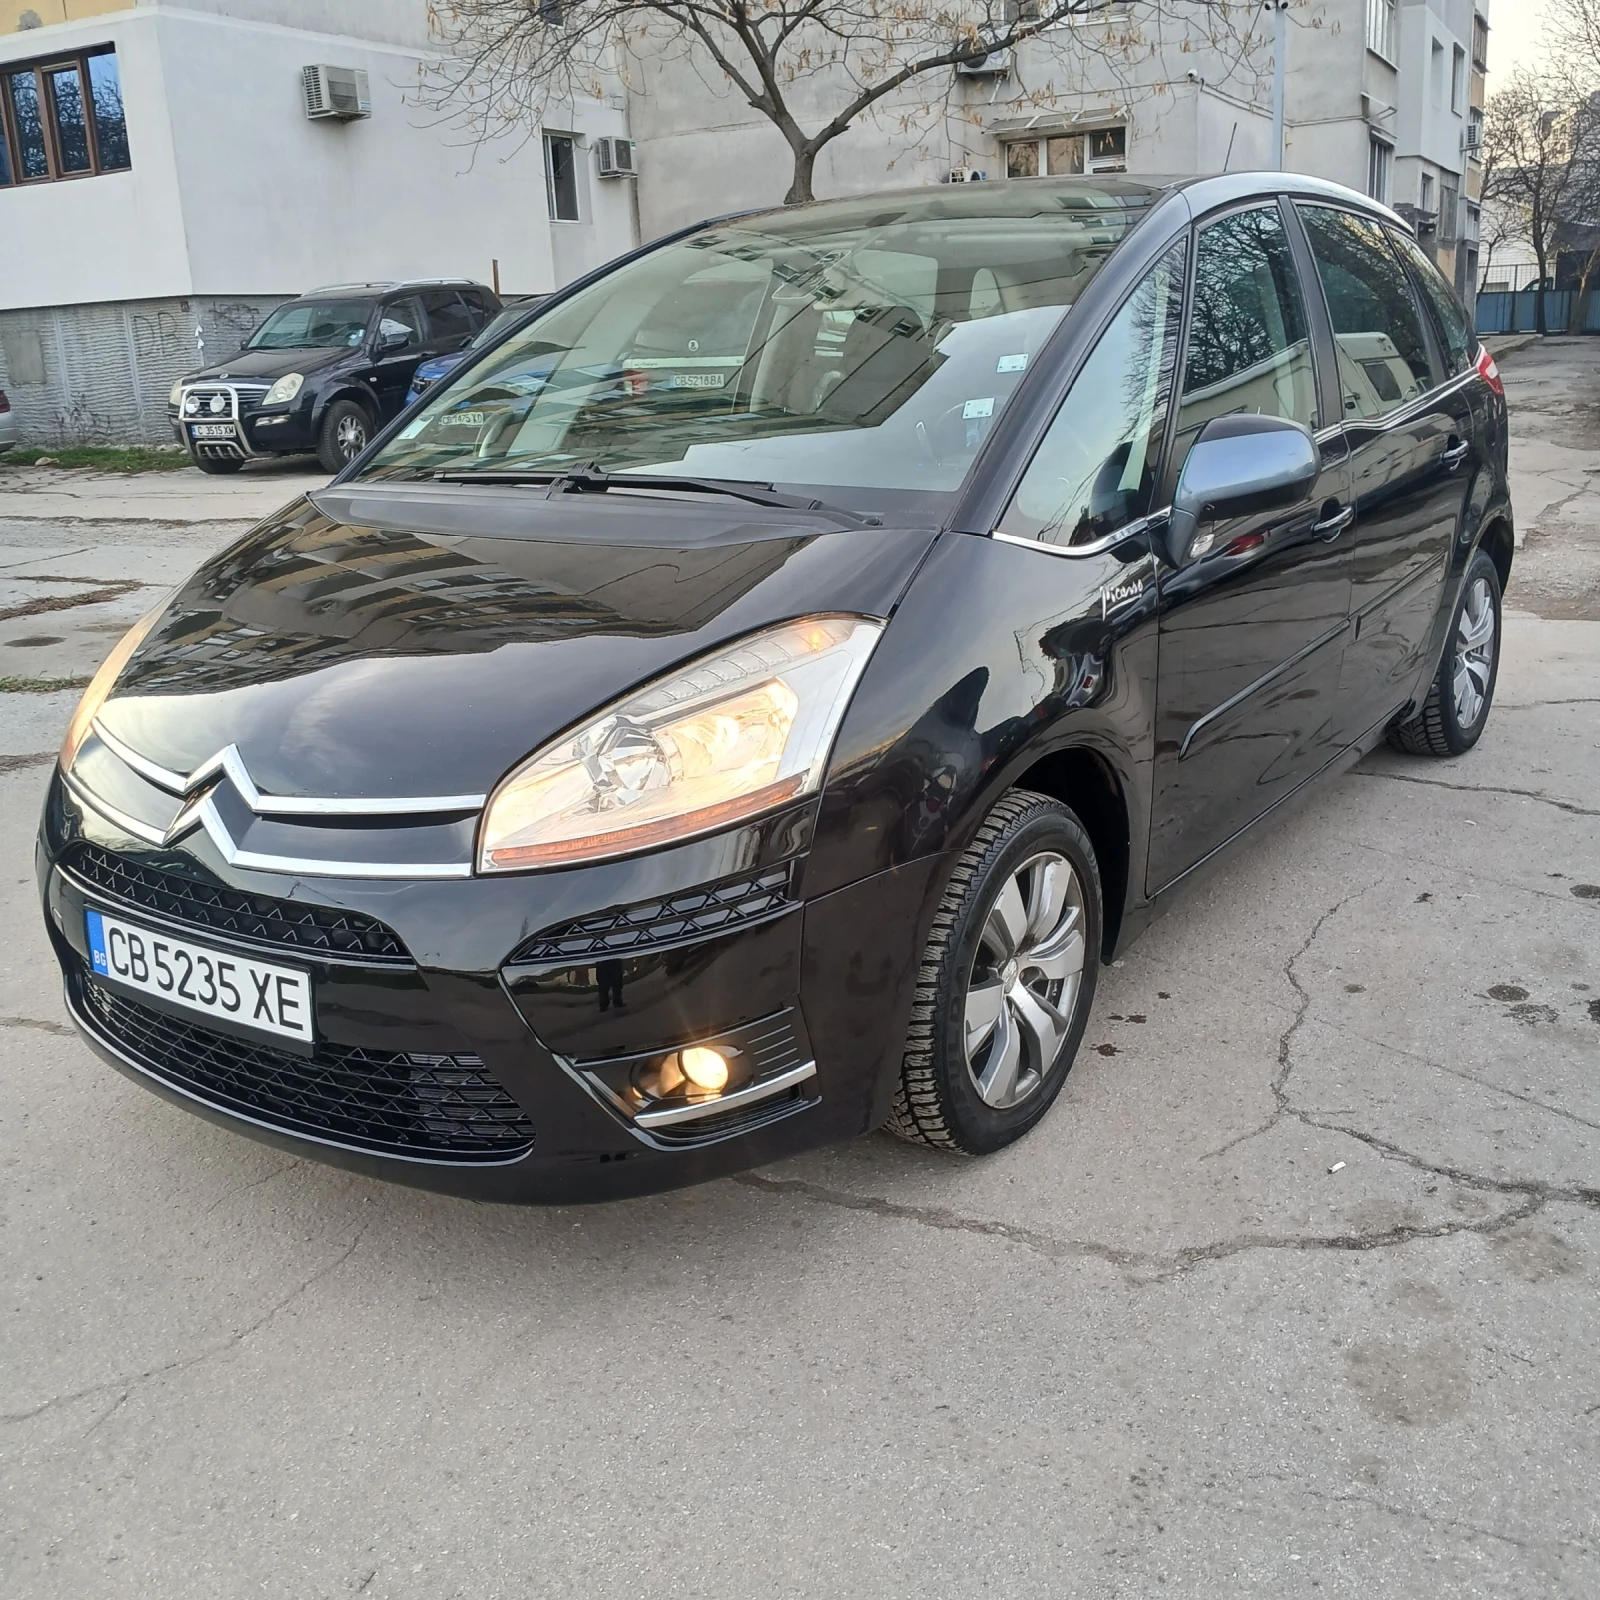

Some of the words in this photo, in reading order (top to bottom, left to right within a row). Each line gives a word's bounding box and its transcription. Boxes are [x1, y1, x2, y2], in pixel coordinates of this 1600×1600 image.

[1099, 578, 1144, 622] Picasso
[93, 949, 107, 968] BG
[153, 940, 242, 1013] 5235
[248, 967, 305, 1032] XE
